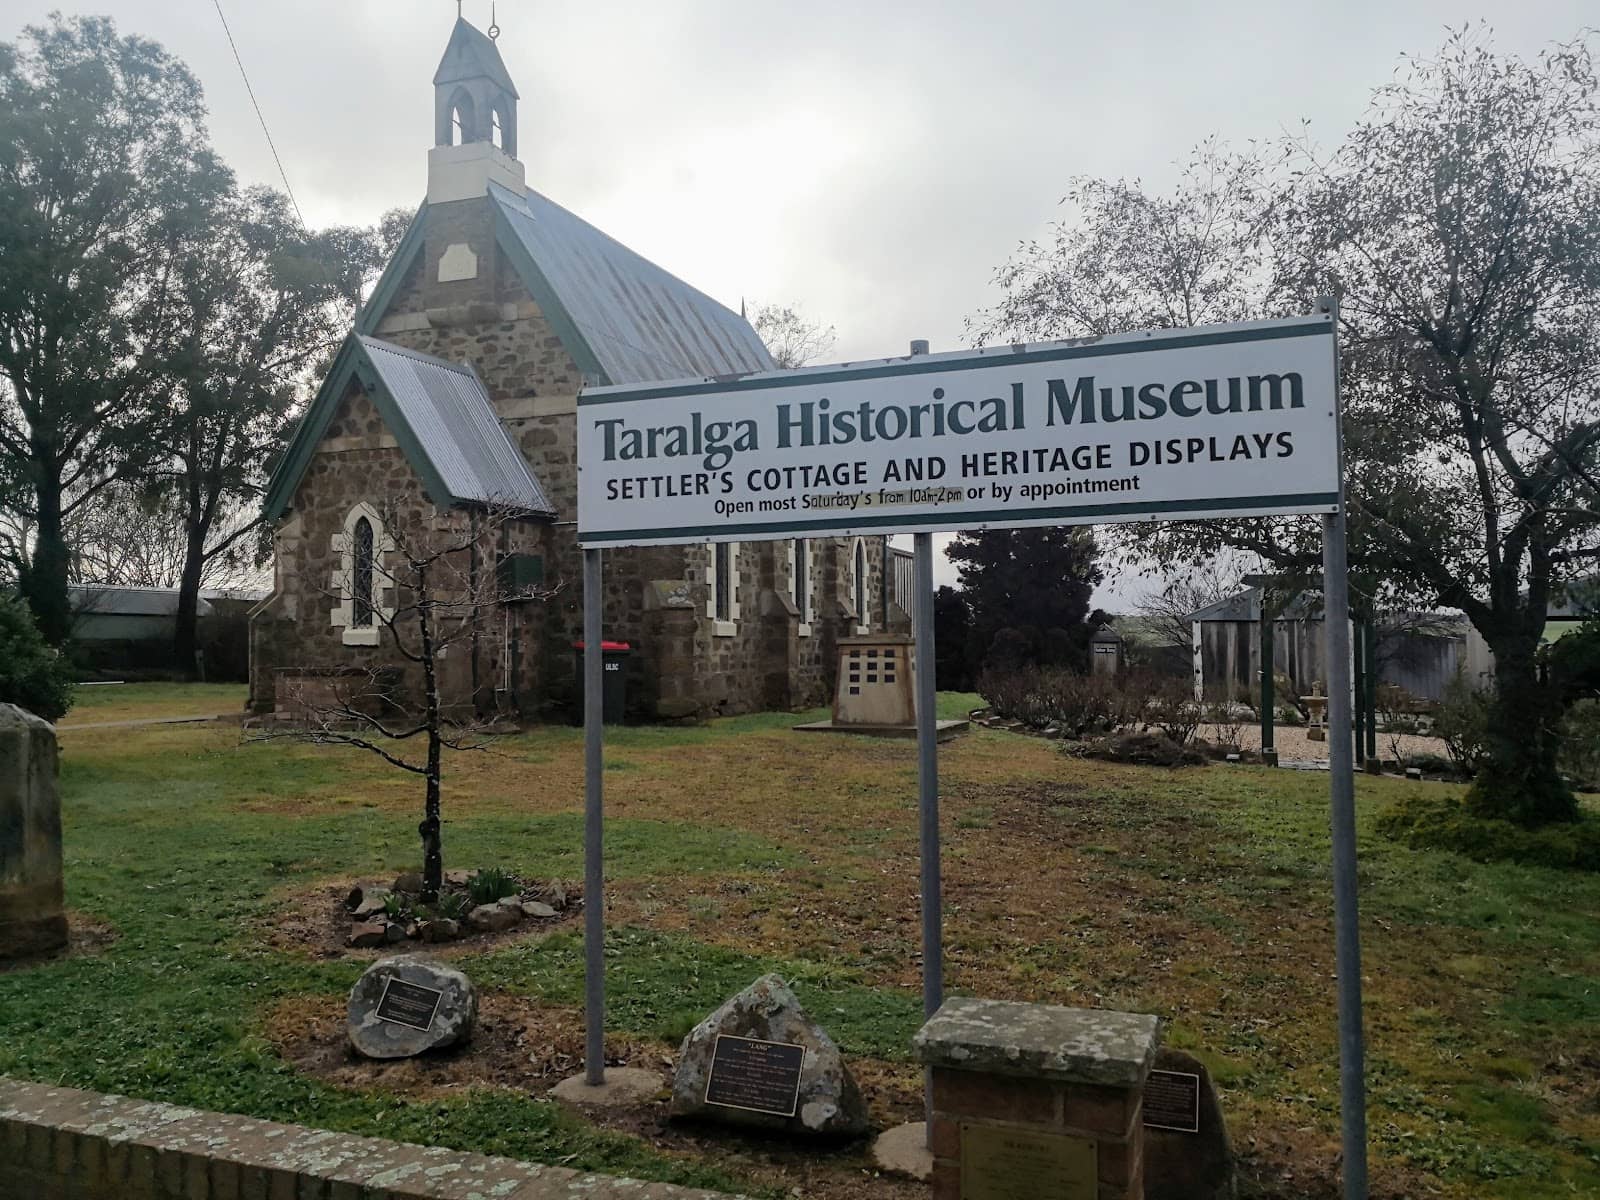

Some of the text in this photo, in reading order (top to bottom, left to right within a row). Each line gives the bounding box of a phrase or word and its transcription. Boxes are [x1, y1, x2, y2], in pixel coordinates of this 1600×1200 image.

[594, 371, 1306, 472] Taralga Historical Museum
[606, 431, 1294, 501] SETTLER'S COTTAGE AND HERITAGE DISPLAYS
[714, 499, 754, 518] Open
[758, 496, 797, 512] most
[879, 488, 904, 505] from
[966, 486, 986, 500] or
[991, 482, 1013, 502] by
[1020, 475, 1141, 501] appointment
